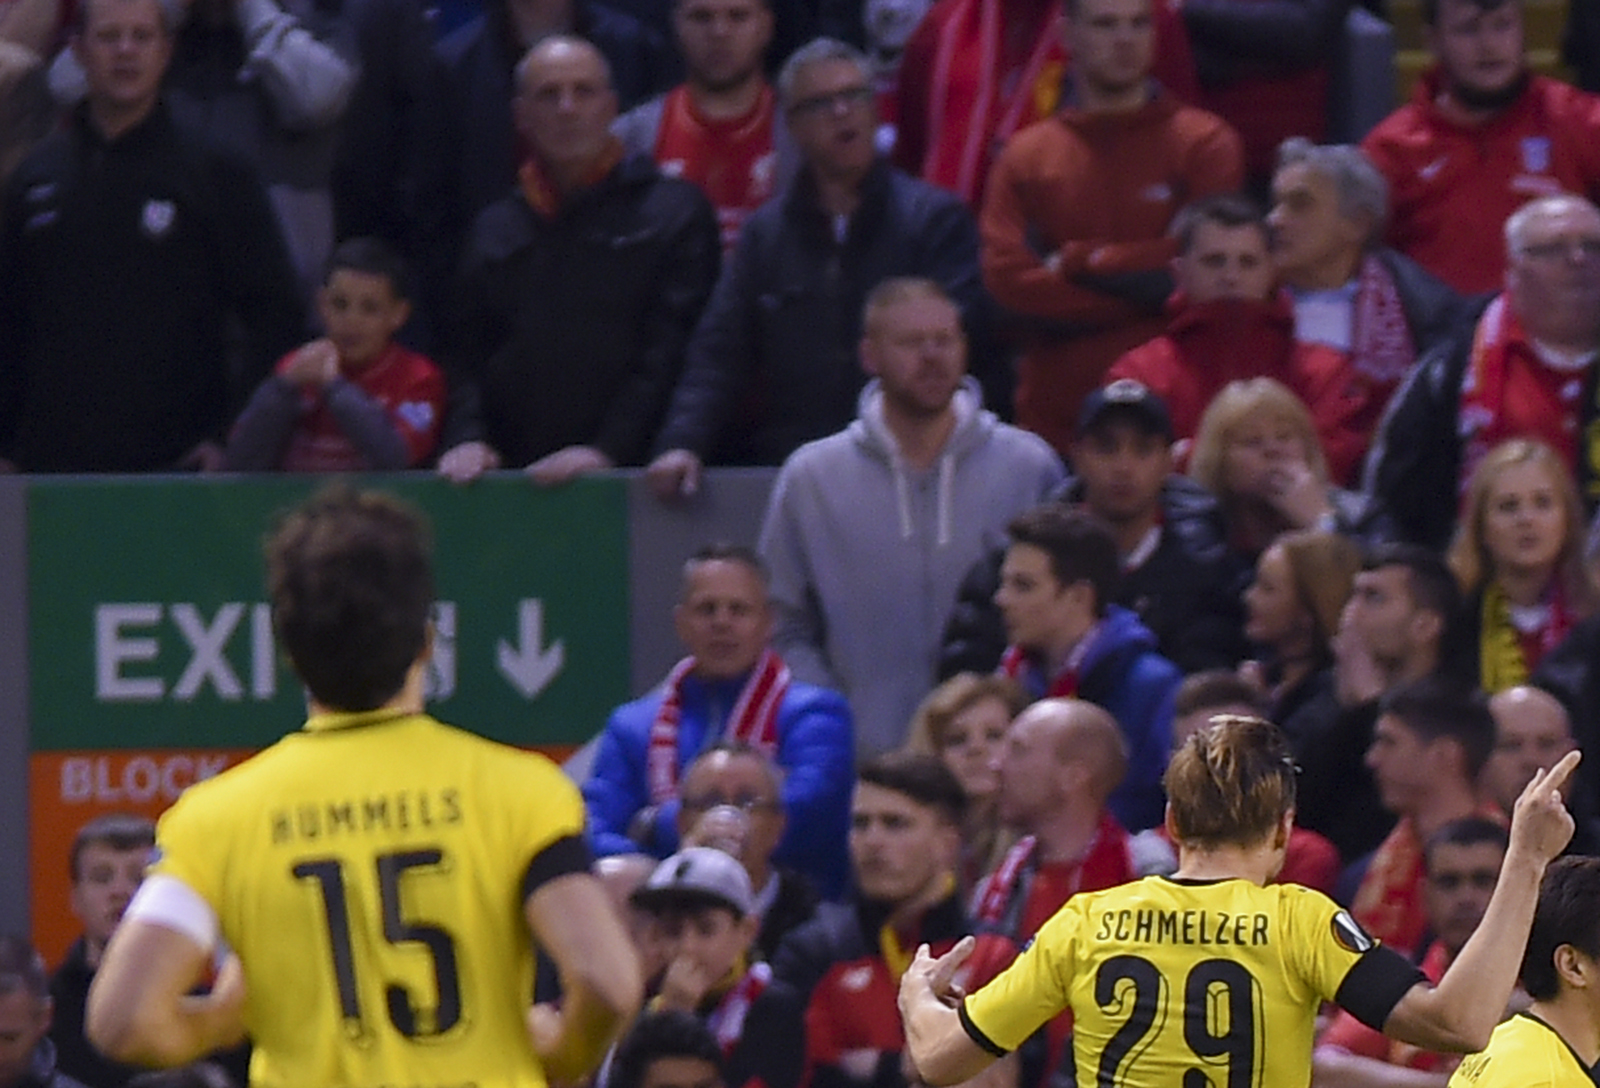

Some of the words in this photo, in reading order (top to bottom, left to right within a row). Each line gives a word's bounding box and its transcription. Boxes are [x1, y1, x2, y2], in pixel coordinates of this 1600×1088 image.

[94, 601, 277, 699] EXI
[271, 789, 465, 845] HUMMELS
[291, 848, 474, 1048] 15
[1096, 909, 1269, 946] SCHMELZER
